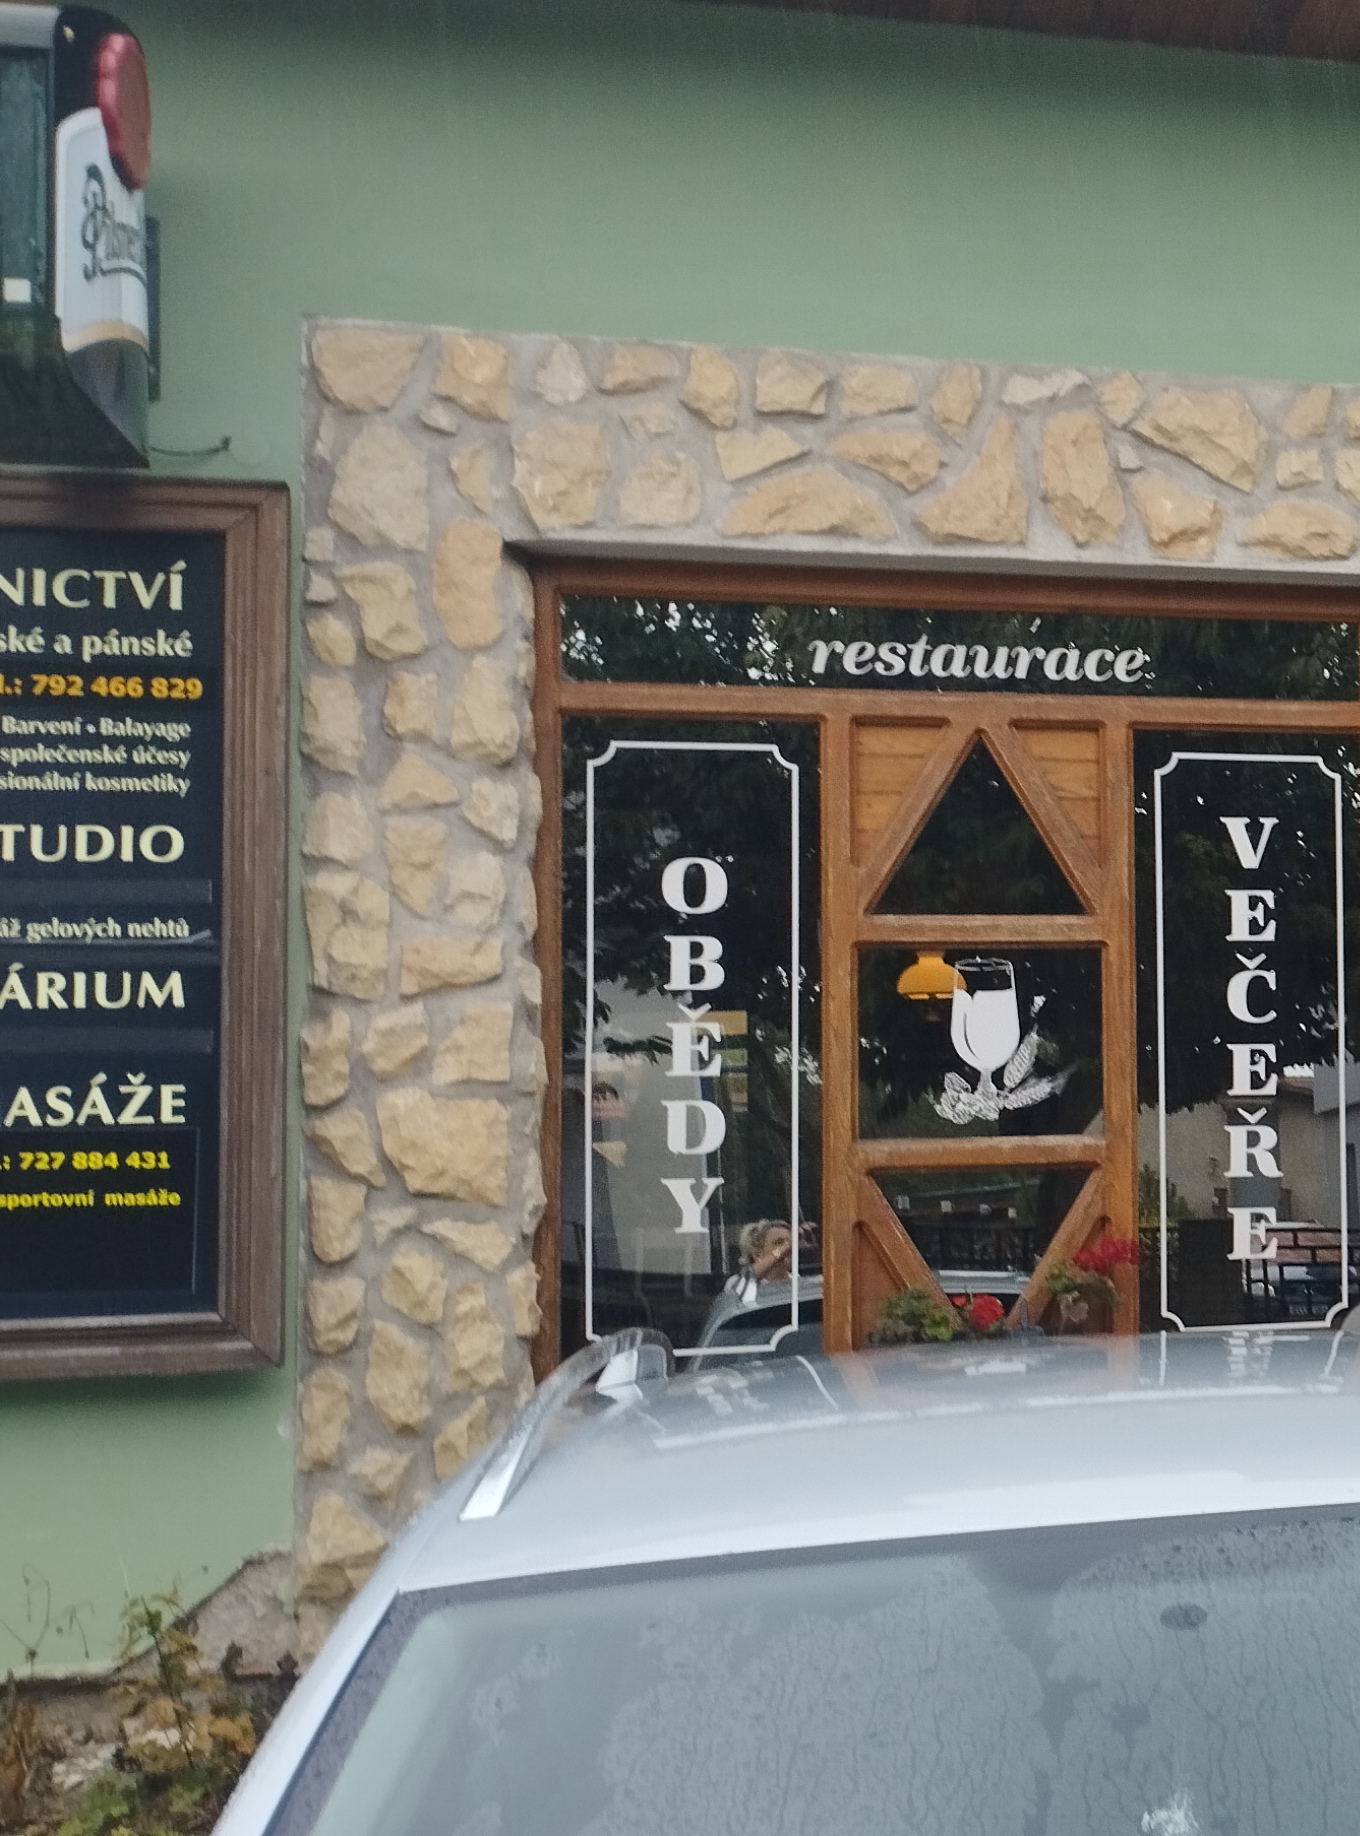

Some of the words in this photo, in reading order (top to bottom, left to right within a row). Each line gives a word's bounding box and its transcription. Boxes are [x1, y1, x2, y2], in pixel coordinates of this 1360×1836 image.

[53, 634, 73, 655] a
[82, 628, 194, 664] pánské
[807, 633, 1149, 683] restaurace
[31, 674, 84, 696] 792
[90, 676, 144, 698] 466
[151, 677, 203, 700] 829
[2, 715, 82, 736] Barvení
[99, 716, 191, 742] Balayage
[132, 744, 191, 770] účesy
[85, 771, 191, 798] kosmetiky
[26, 917, 122, 944] gelových
[127, 917, 190, 938] nehtů
[660, 856, 729, 1234] OBĚDY
[1219, 816, 1284, 1262] VEČEŘE
[19, 1151, 66, 1171] 727
[71, 1151, 119, 1170] 884
[125, 1151, 171, 1171] 431
[104, 1188, 182, 1207] masáže
